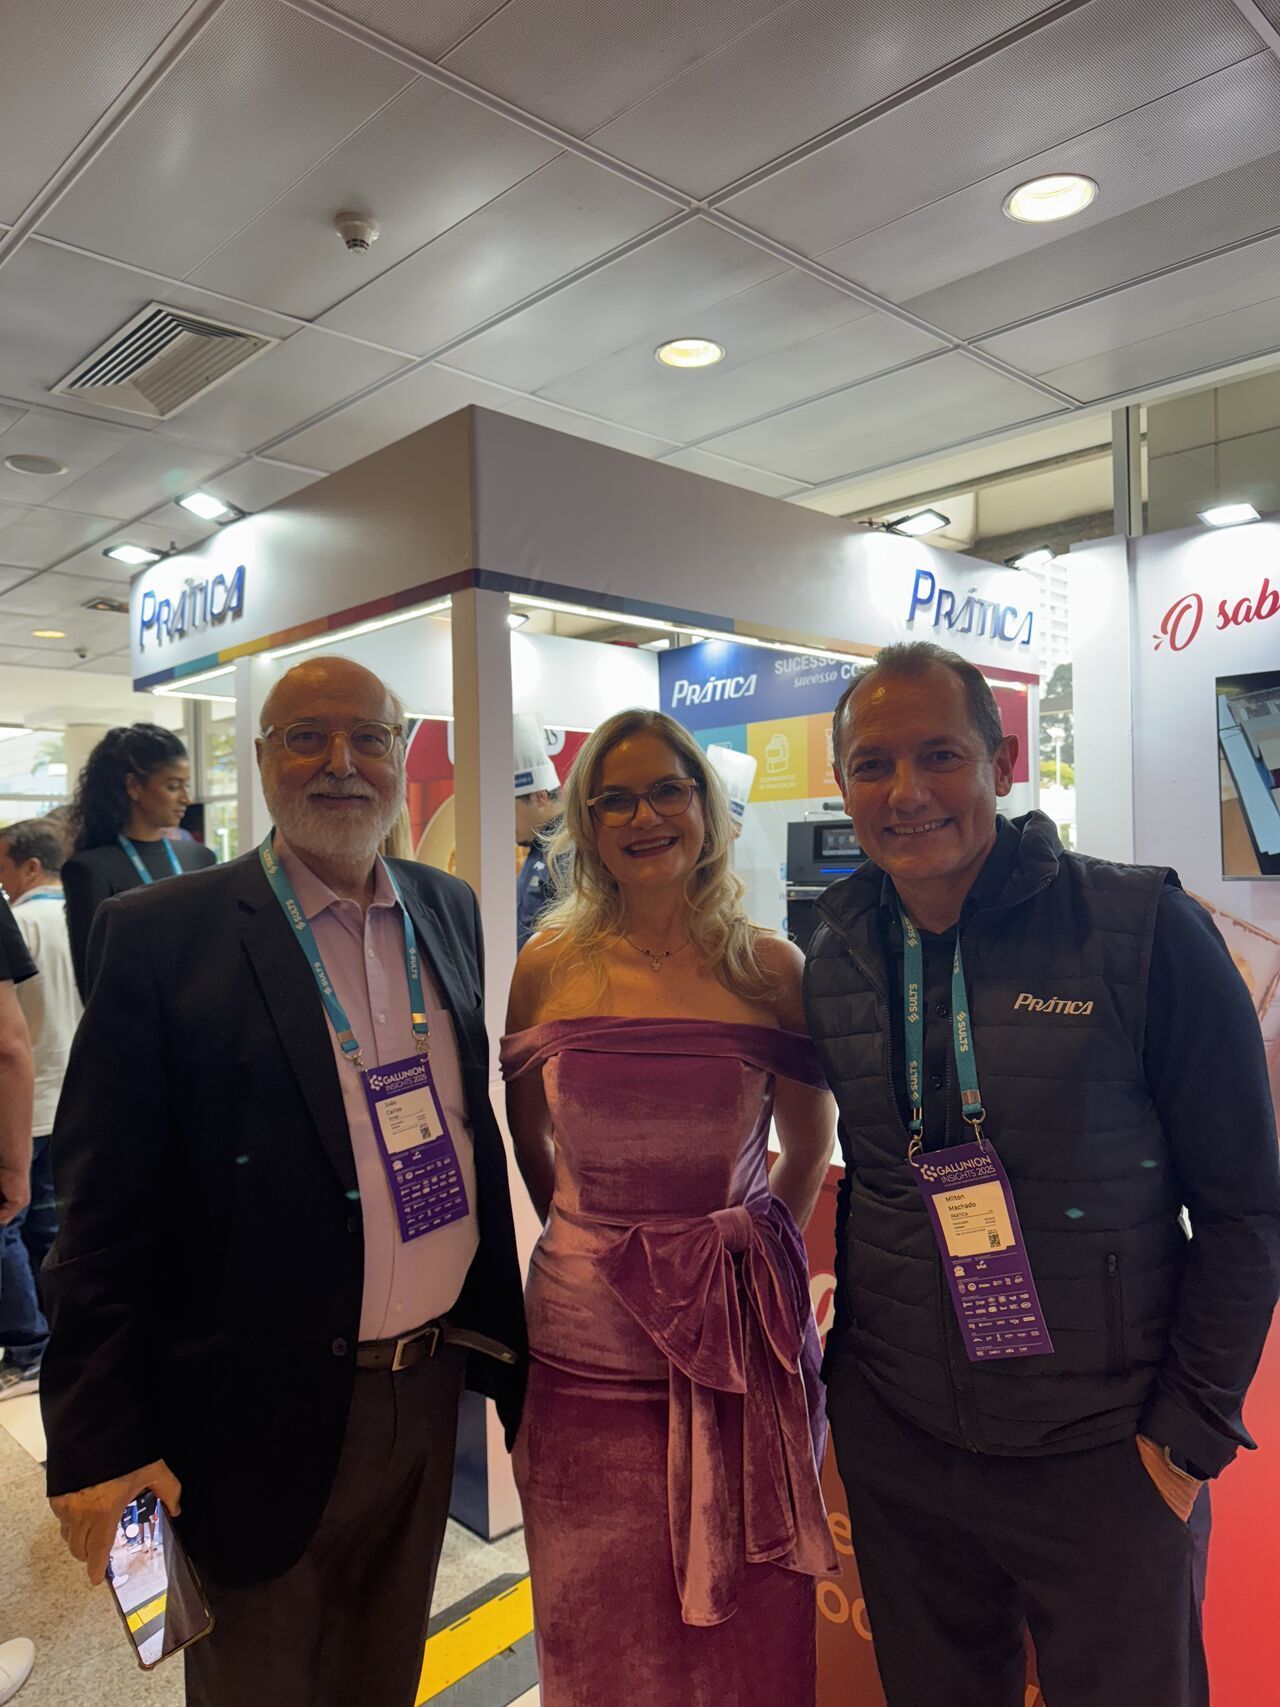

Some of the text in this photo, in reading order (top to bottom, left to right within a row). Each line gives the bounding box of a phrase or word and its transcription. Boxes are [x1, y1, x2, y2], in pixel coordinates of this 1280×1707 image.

[906, 568, 1033, 645] PRÁTICA
[1160, 593, 1203, 651] O
[671, 674, 758, 708] PRÁTICA
[793, 671, 838, 688] sucesso
[314, 961, 328, 988] SULTS
[410, 953, 418, 980] SULTS
[909, 983, 918, 1012] SULTS
[1013, 992, 1095, 1015] PRÁTICA
[959, 1020, 969, 1052] SULTS
[382, 1065, 425, 1085] GALUNION
[909, 1060, 919, 1091] SULTS
[936, 1155, 992, 1176] GALUNION
[941, 1168, 977, 1184] INSIGHTS
[977, 1164, 996, 1176] 2025
[945, 1194, 965, 1202] Milton
[948, 1202, 977, 1212] Machado
